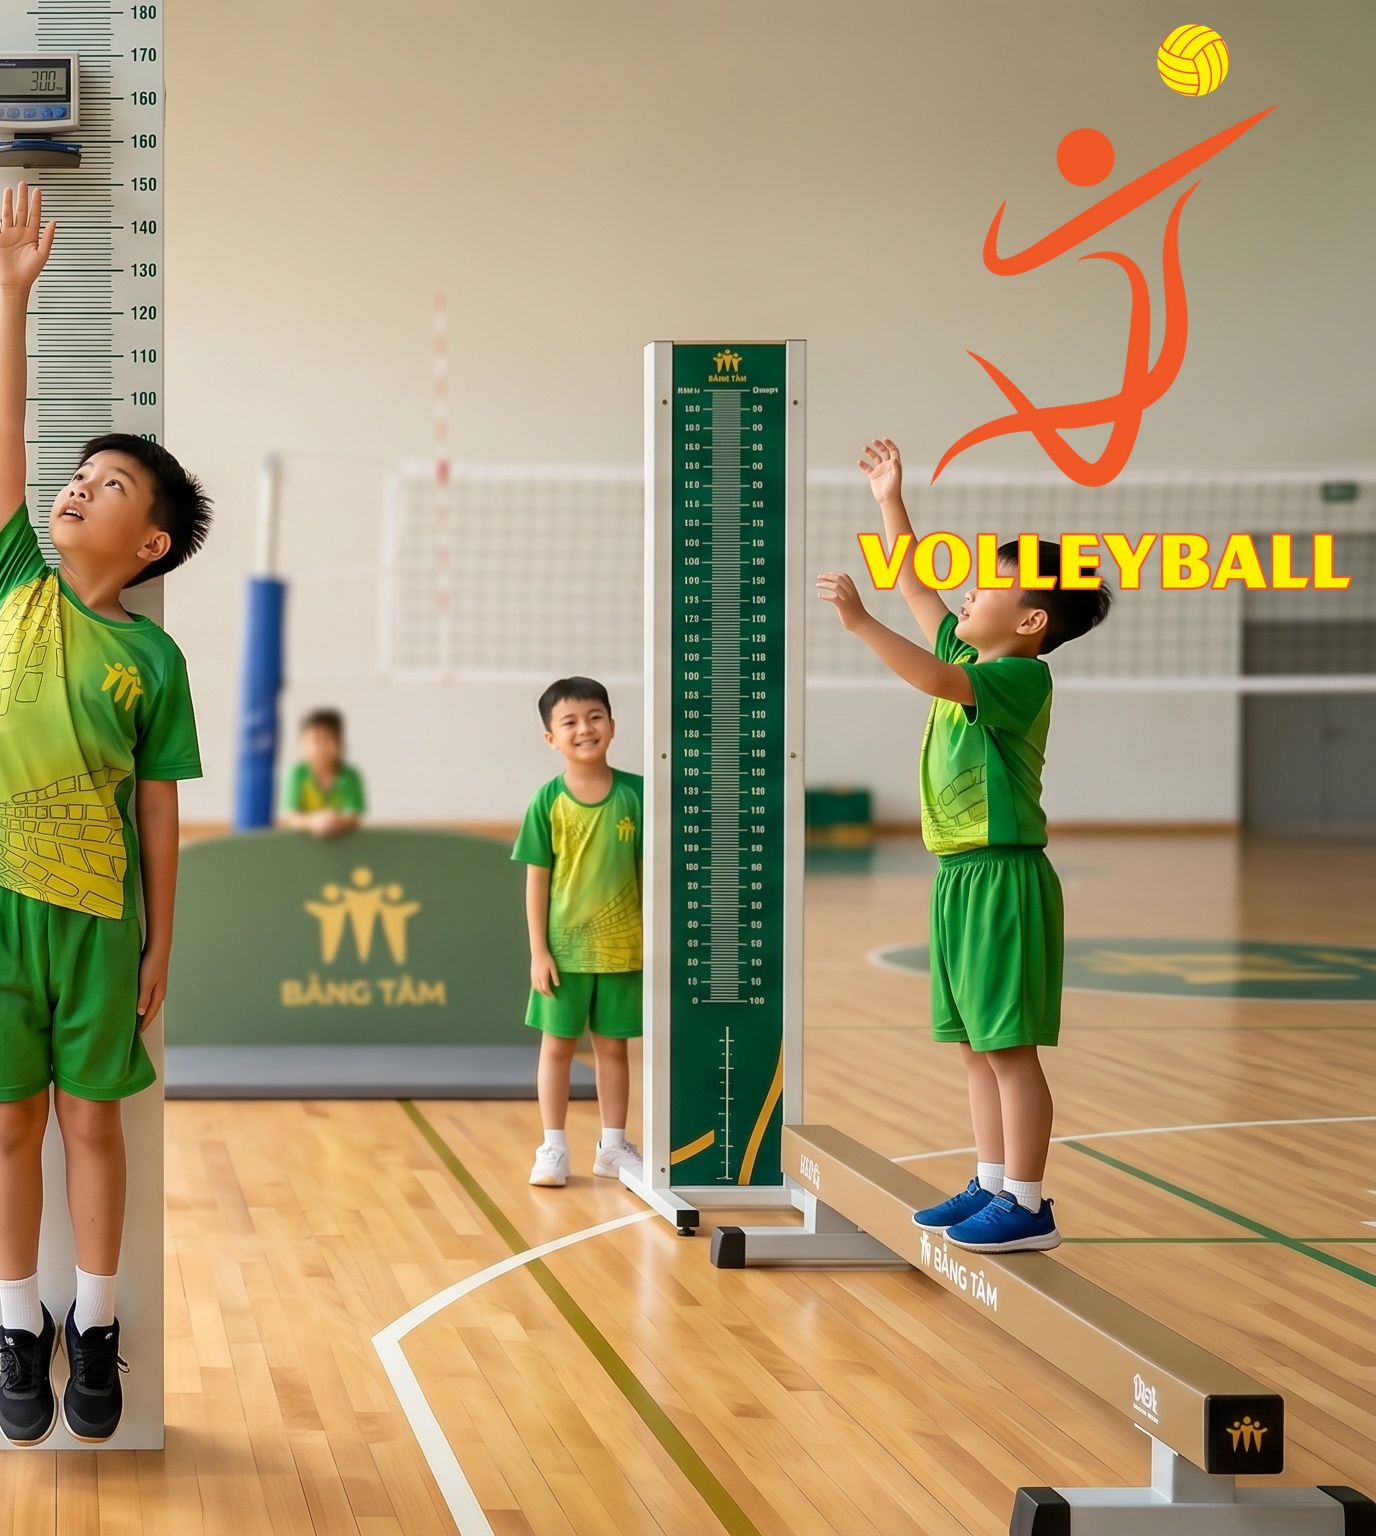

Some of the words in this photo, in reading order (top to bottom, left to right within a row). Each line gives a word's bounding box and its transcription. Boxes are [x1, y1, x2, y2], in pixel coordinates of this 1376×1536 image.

[130, 5, 157, 19] 180
[130, 48, 157, 62] 170
[30, 70, 57, 92] 300
[130, 91, 157, 105] 160
[130, 134, 157, 148] 160
[130, 177, 157, 191] 150
[130, 220, 157, 234] 140
[130, 263, 157, 277] 130
[130, 306, 157, 320] 120
[130, 349, 157, 363] 110
[130, 391, 157, 406] 100
[970, 1270, 998, 1312] TÂM
